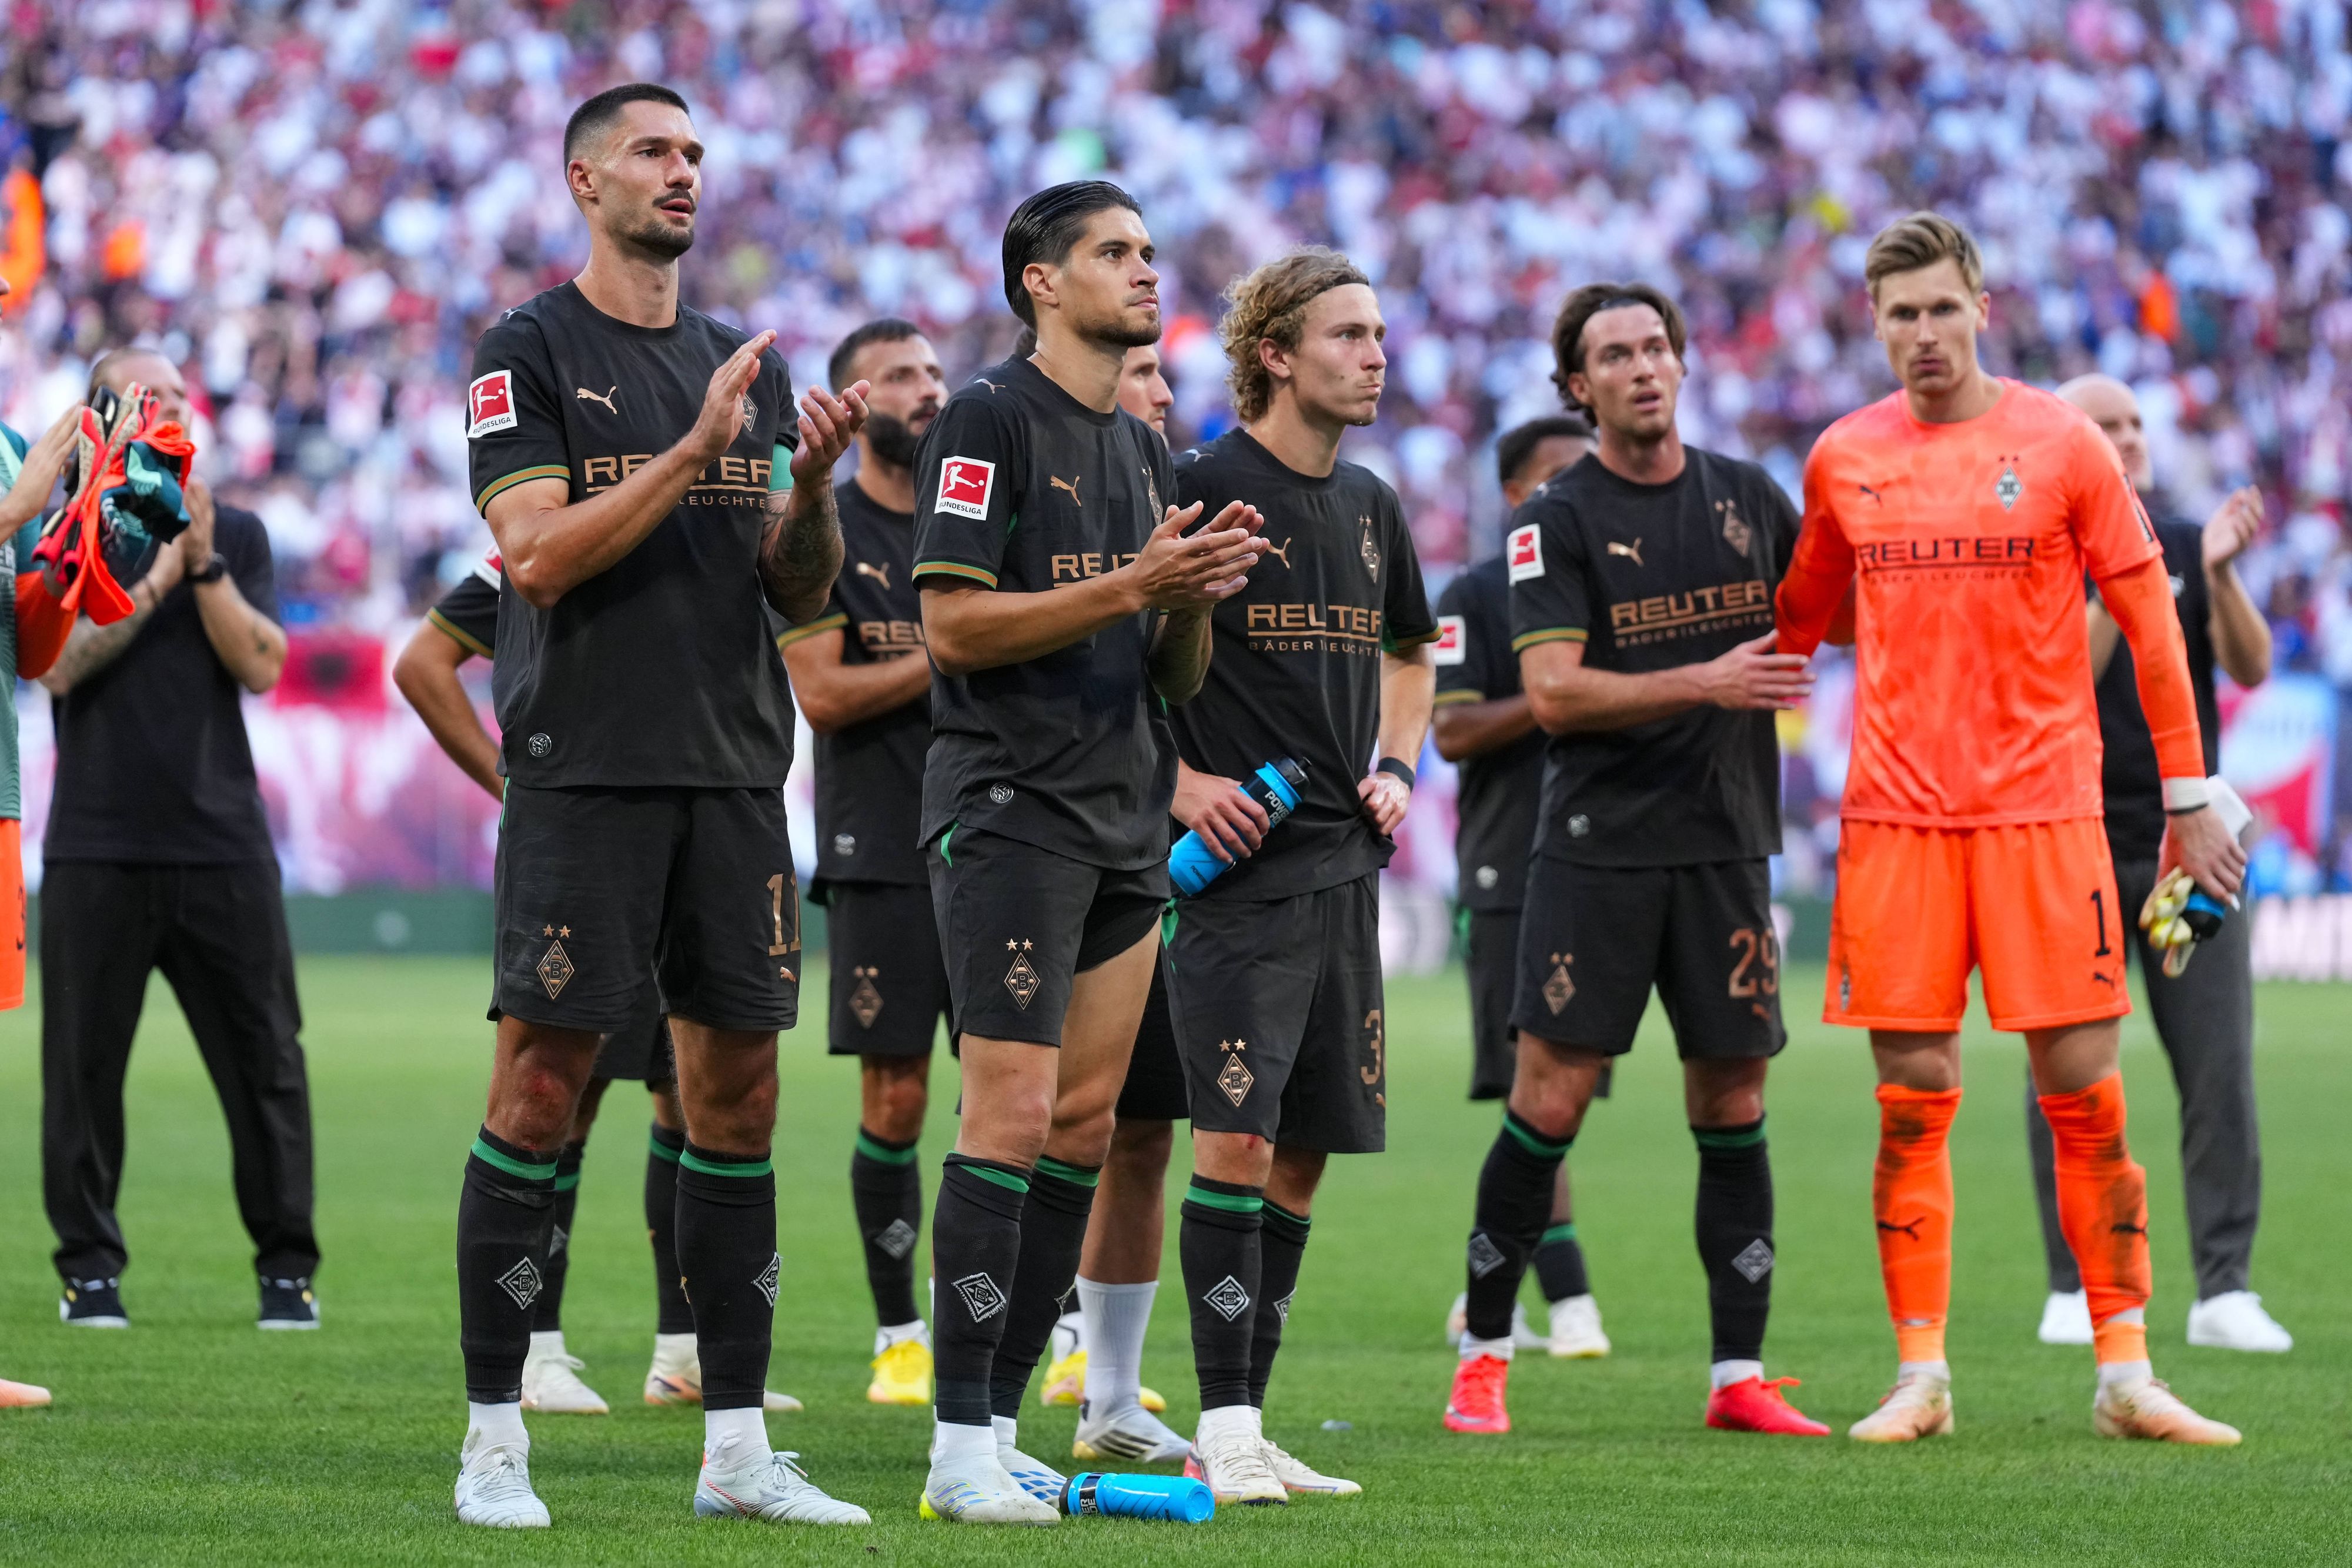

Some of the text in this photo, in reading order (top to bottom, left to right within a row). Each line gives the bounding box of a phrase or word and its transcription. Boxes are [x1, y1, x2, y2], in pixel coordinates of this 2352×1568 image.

[473, 417, 511, 434] BUNDESLIGA
[584, 454, 772, 484] REER
[939, 501, 981, 515] BUNDESLIGA
[1858, 537, 2033, 563] REUTER
[1611, 579, 1769, 628] REUTER
[1248, 640, 1314, 651] BÄDER
[767, 871, 801, 957] 11
[2090, 889, 2111, 957] 1
[1729, 927, 1778, 997] 29
